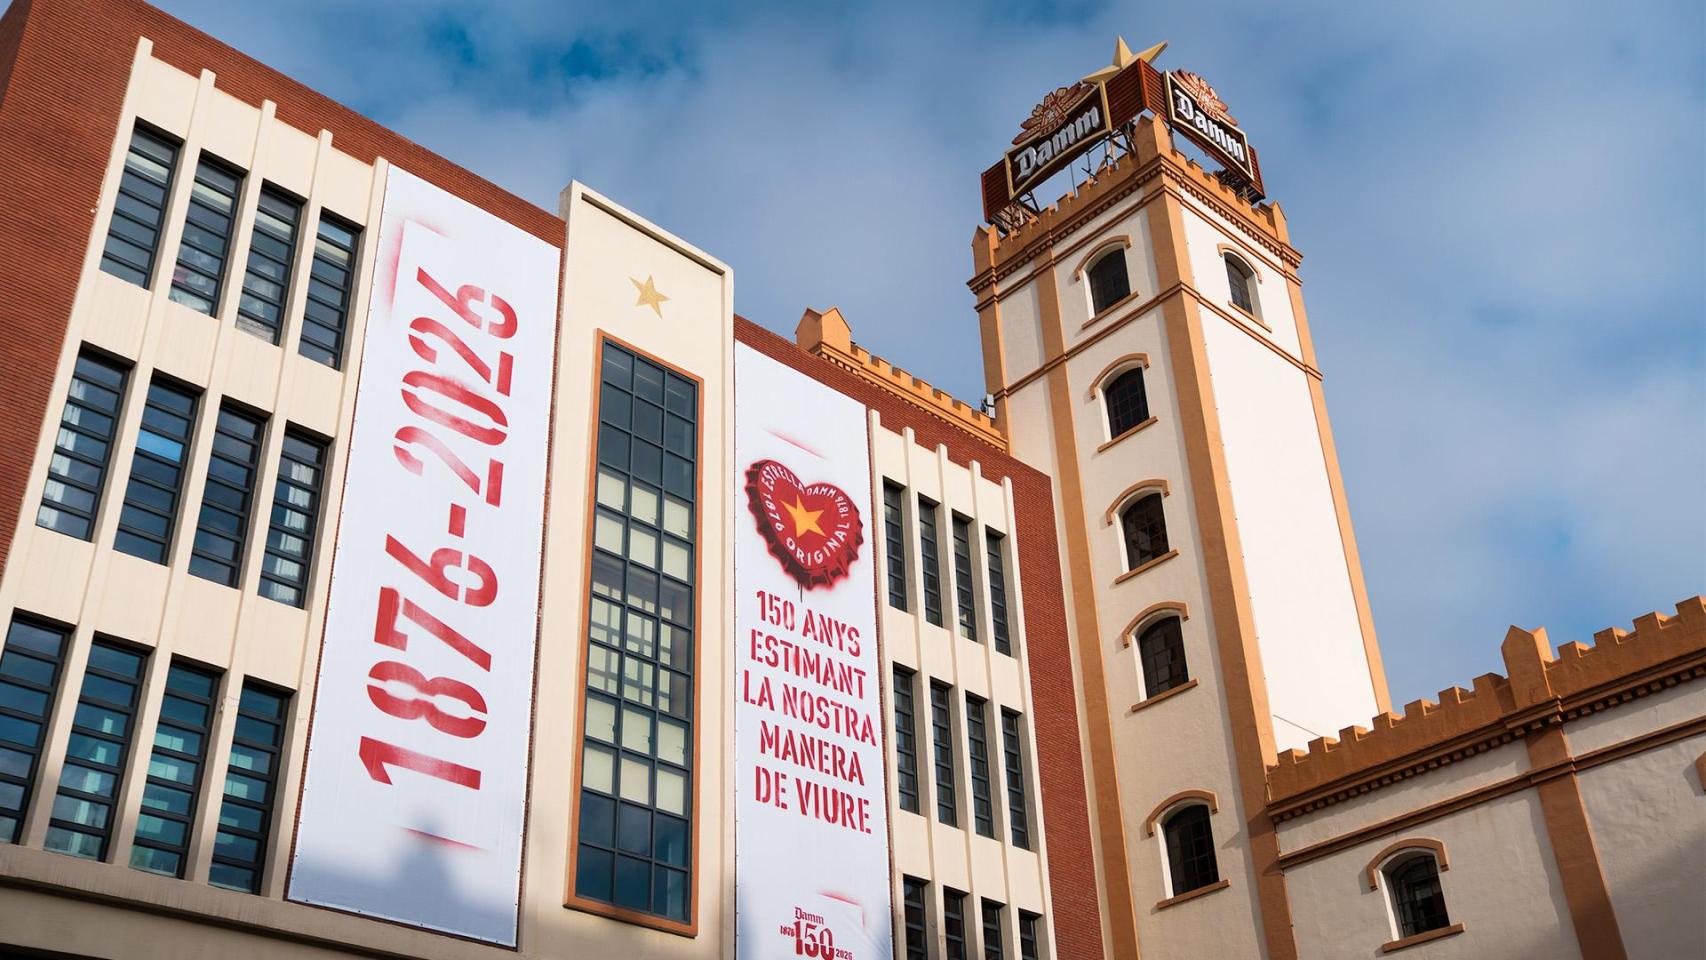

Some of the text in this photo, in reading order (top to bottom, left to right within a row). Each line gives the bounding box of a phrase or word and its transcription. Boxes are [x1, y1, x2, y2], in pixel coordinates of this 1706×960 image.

[1014, 106, 1100, 182] Damm
[1173, 89, 1245, 162] Damm
[761, 465, 837, 498] ESTRELLA DAMM
[358, 267, 518, 790] 1876-2026
[762, 492, 785, 532] 1876
[786, 522, 850, 566] ORIGINAL
[756, 590, 861, 657] 150 ANYS
[751, 629, 867, 699] ESTIMANT
[743, 670, 877, 747] LA NOSTRA
[760, 720, 865, 786] MANERA
[755, 766, 872, 834] DE VIURE
[794, 920, 835, 960] 150
[795, 907, 824, 925] Damm
